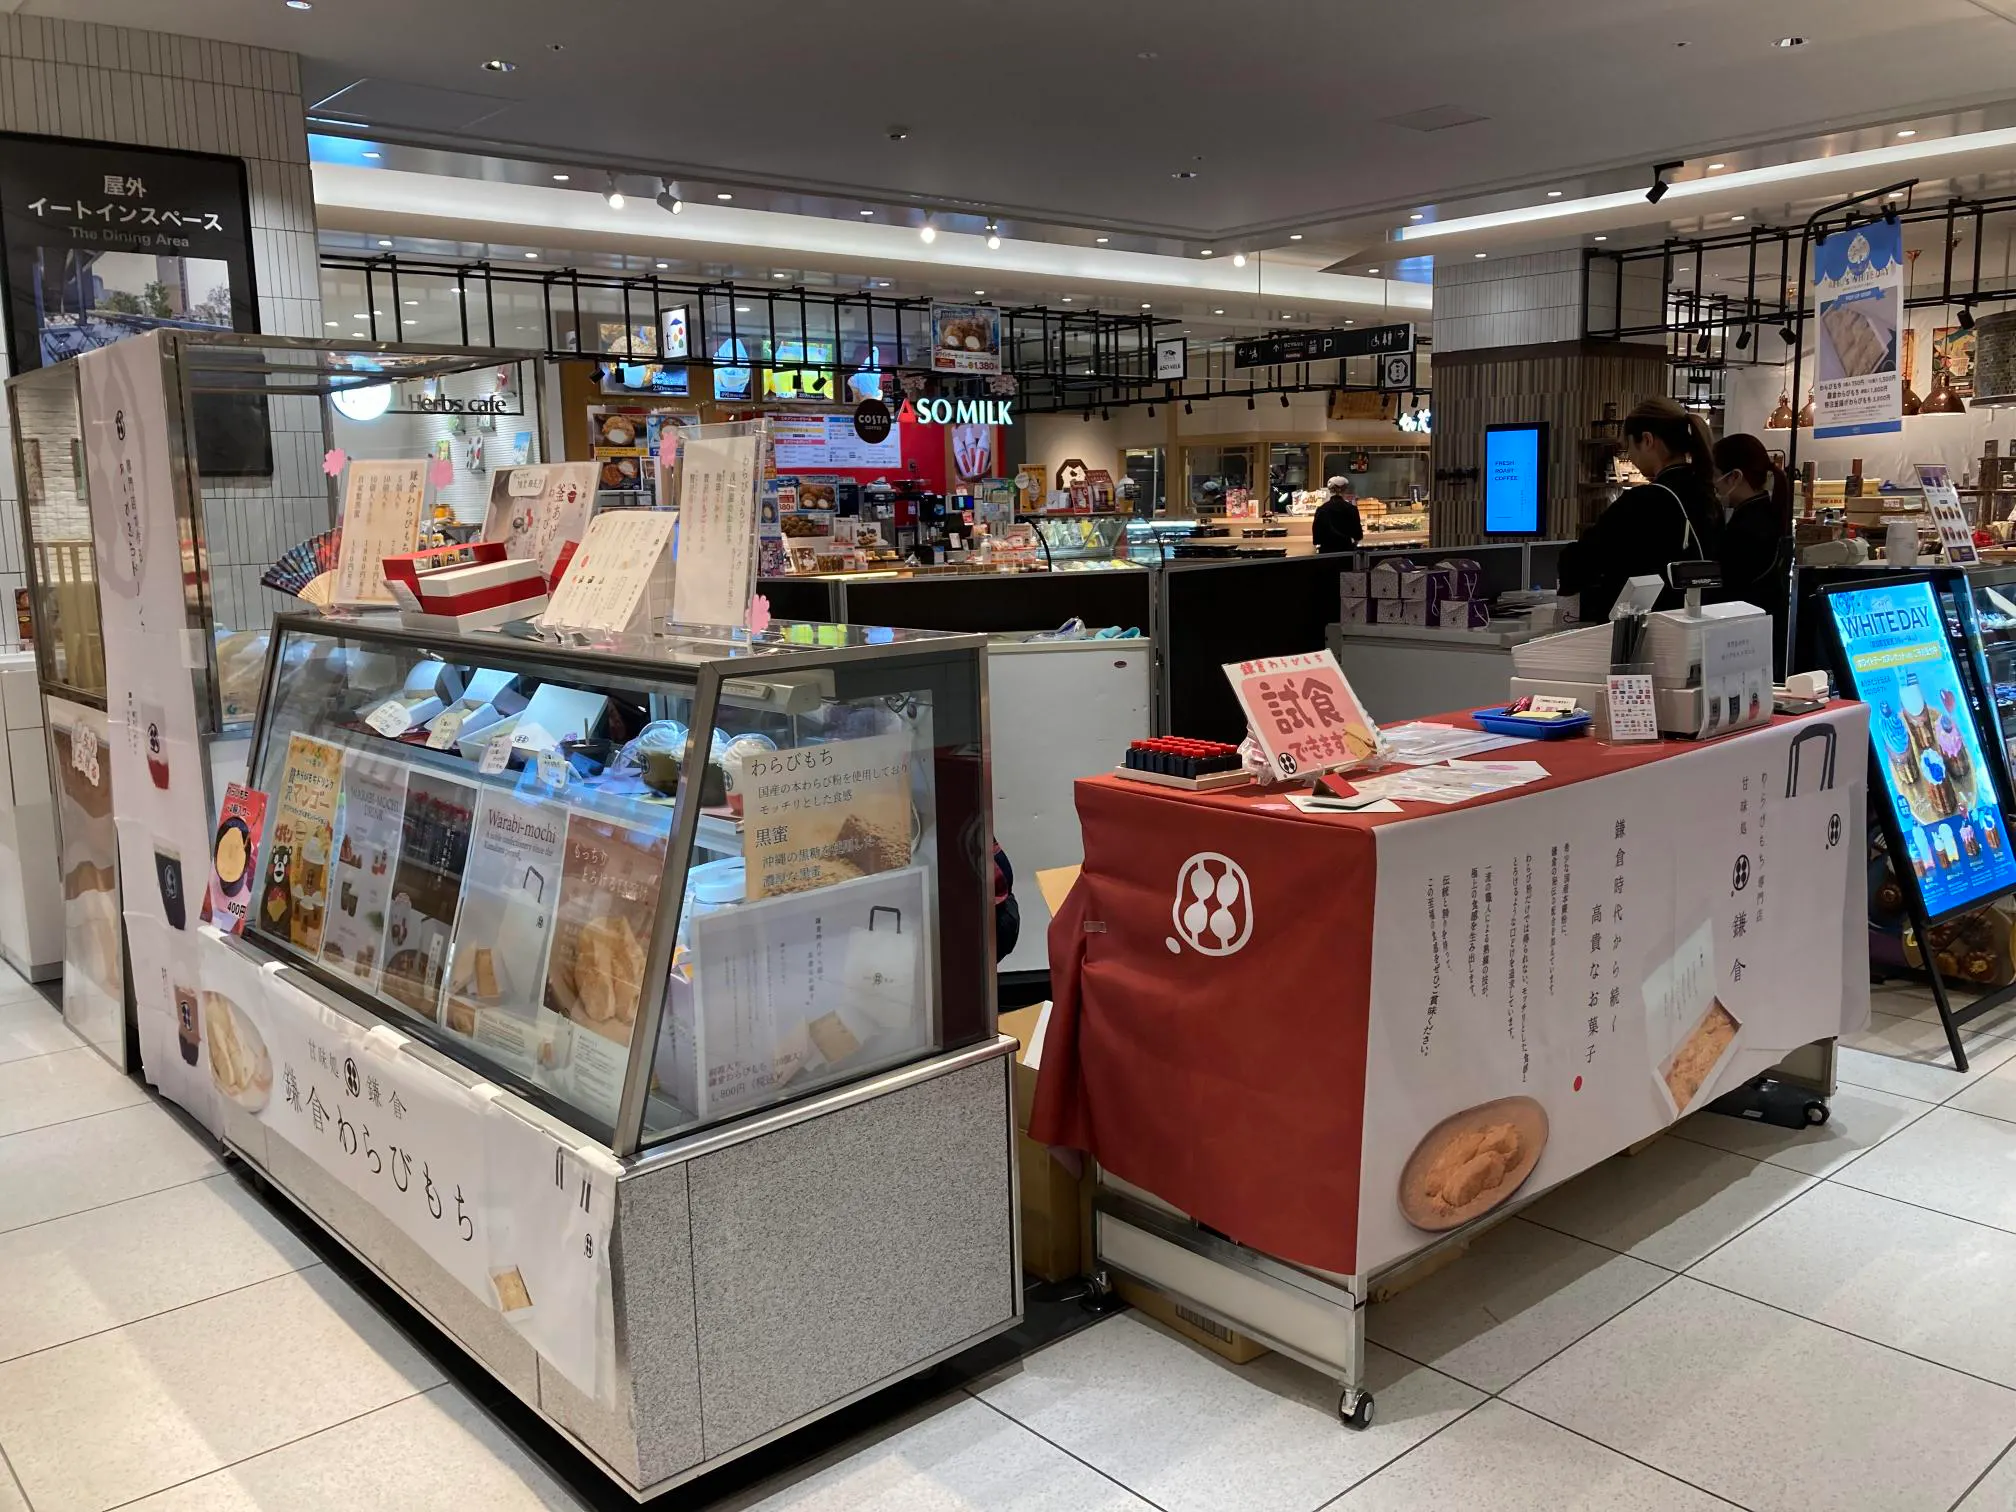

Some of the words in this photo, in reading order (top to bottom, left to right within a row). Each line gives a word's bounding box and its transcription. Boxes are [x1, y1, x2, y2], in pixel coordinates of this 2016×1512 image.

[104, 175, 147, 198] 屋外
[28, 198, 223, 231] イートインスペース
[69, 227, 98, 240] The
[102, 228, 150, 246] Dining
[156, 233, 190, 248] Area
[1323, 339, 1333, 352] P
[858, 415, 888, 425] COSTA
[897, 398, 952, 425] ASO
[957, 400, 1013, 425] MILK
[1841, 610, 1899, 638] WHITE
[1897, 605, 1930, 630] DAY
[1259, 677, 1345, 735] 試食
[1288, 729, 1348, 763] できます
[751, 748, 833, 777] わらびもち
[294, 783, 330, 810] マンゴー
[758, 764, 908, 799] 国産の本わらび粉を使用しており
[760, 790, 853, 815] モッチリとした食感
[488, 808, 557, 844] Warabi-mochi
[755, 825, 788, 848] 黒蜜
[227, 901, 247, 918] 400円
[1731, 911, 1748, 982] 鎌倉
[1585, 903, 1603, 1064] 高貴なお菓子
[308, 1038, 340, 1080] 甘味処
[367, 1075, 408, 1120] 鎌倉
[283, 1061, 474, 1242] 鎌倉わらびもち
